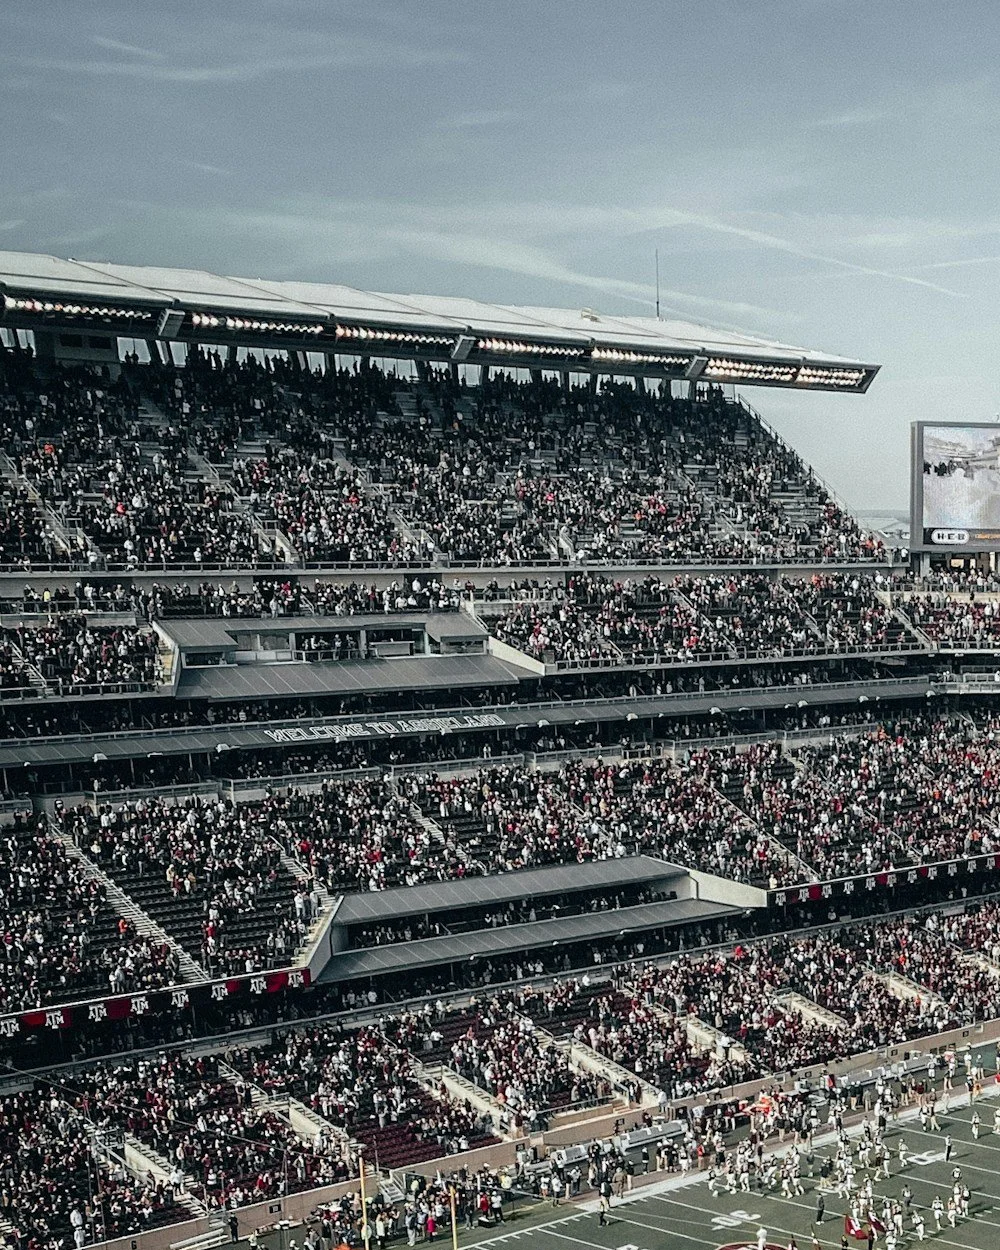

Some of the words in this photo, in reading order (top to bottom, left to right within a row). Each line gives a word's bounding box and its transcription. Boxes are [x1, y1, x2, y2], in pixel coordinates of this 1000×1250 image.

[264, 722, 370, 743] WELCOME
[366, 721, 399, 736] TO
[398, 713, 507, 732] AGGIELAND
